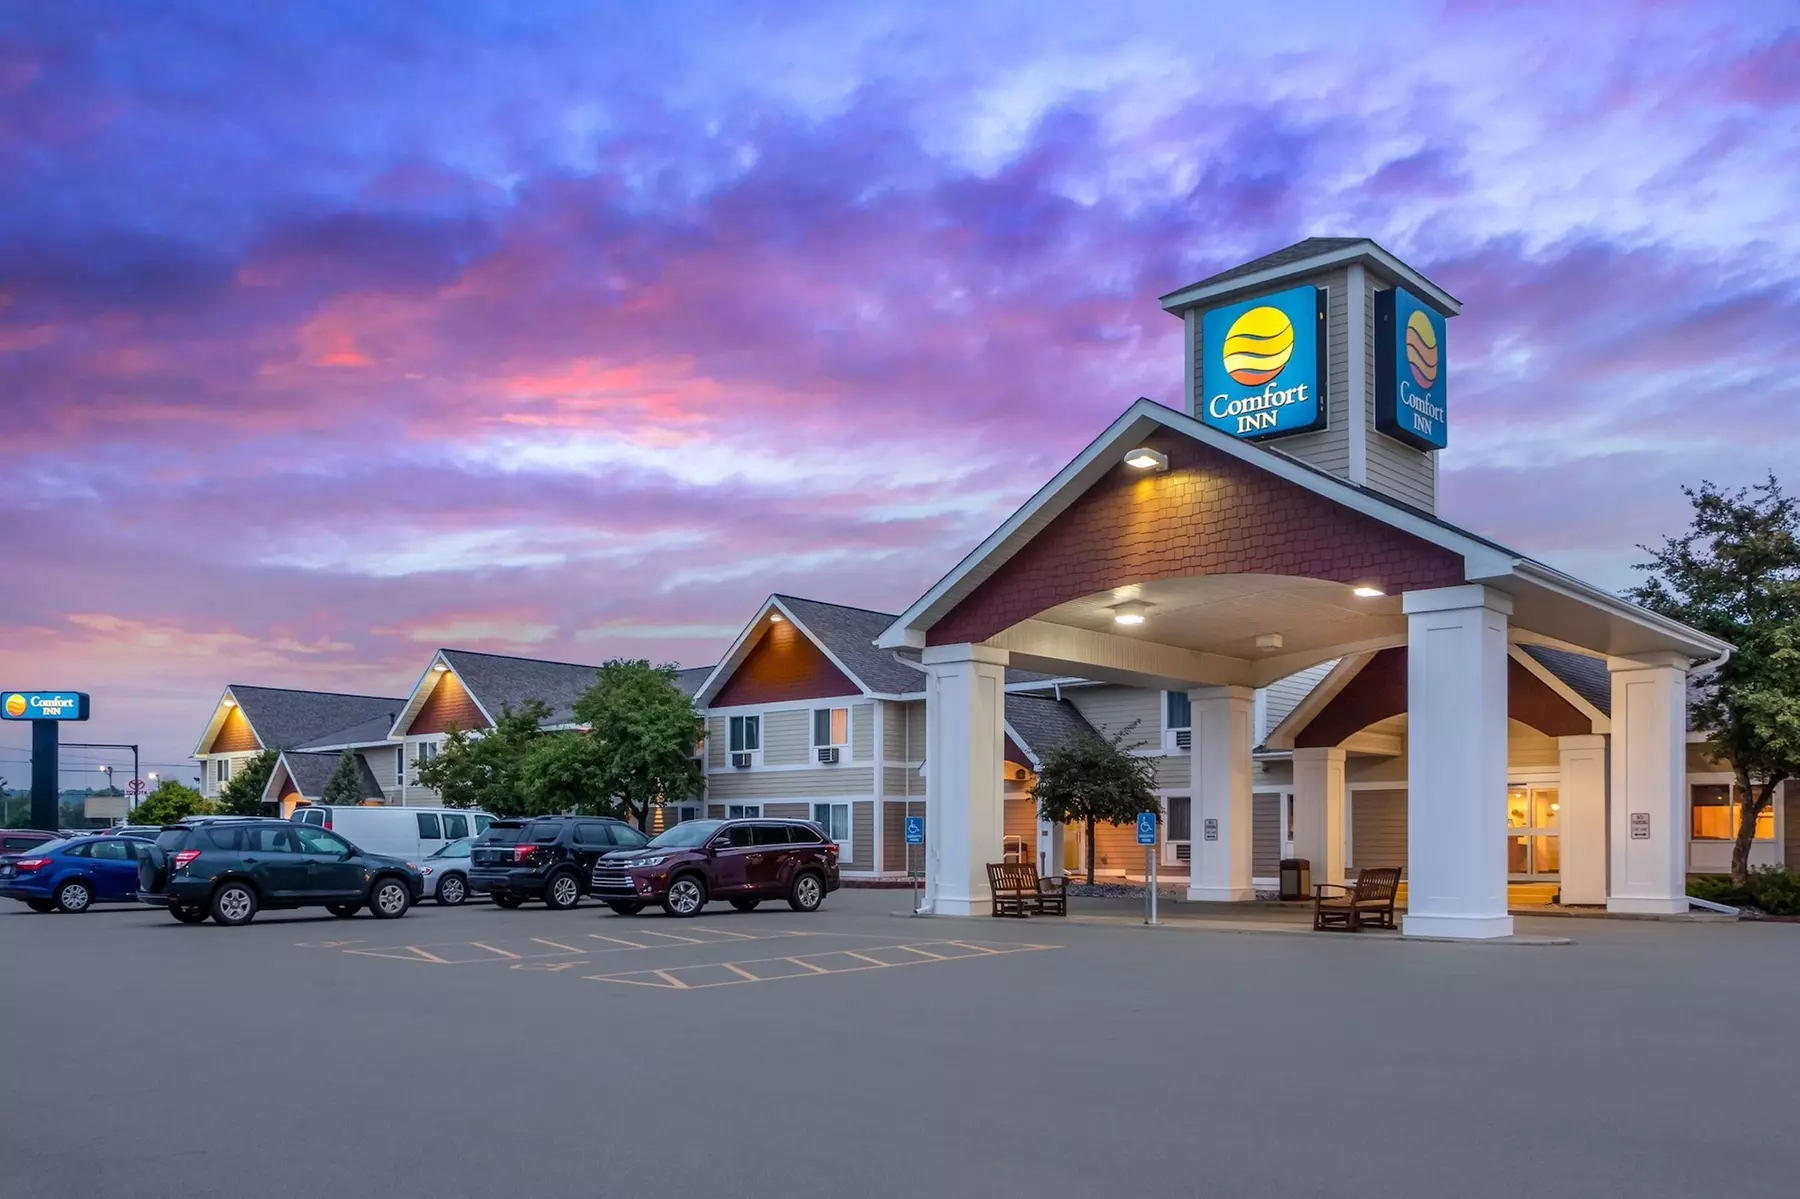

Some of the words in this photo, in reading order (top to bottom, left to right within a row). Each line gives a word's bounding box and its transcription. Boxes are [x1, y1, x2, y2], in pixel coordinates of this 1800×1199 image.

[1209, 382, 1308, 418] Comfort
[1400, 380, 1444, 423] Comfort
[1236, 410, 1278, 433] INN
[1413, 413, 1432, 436] INN
[30, 696, 74, 707] Comfort
[42, 707, 61, 715] INN
